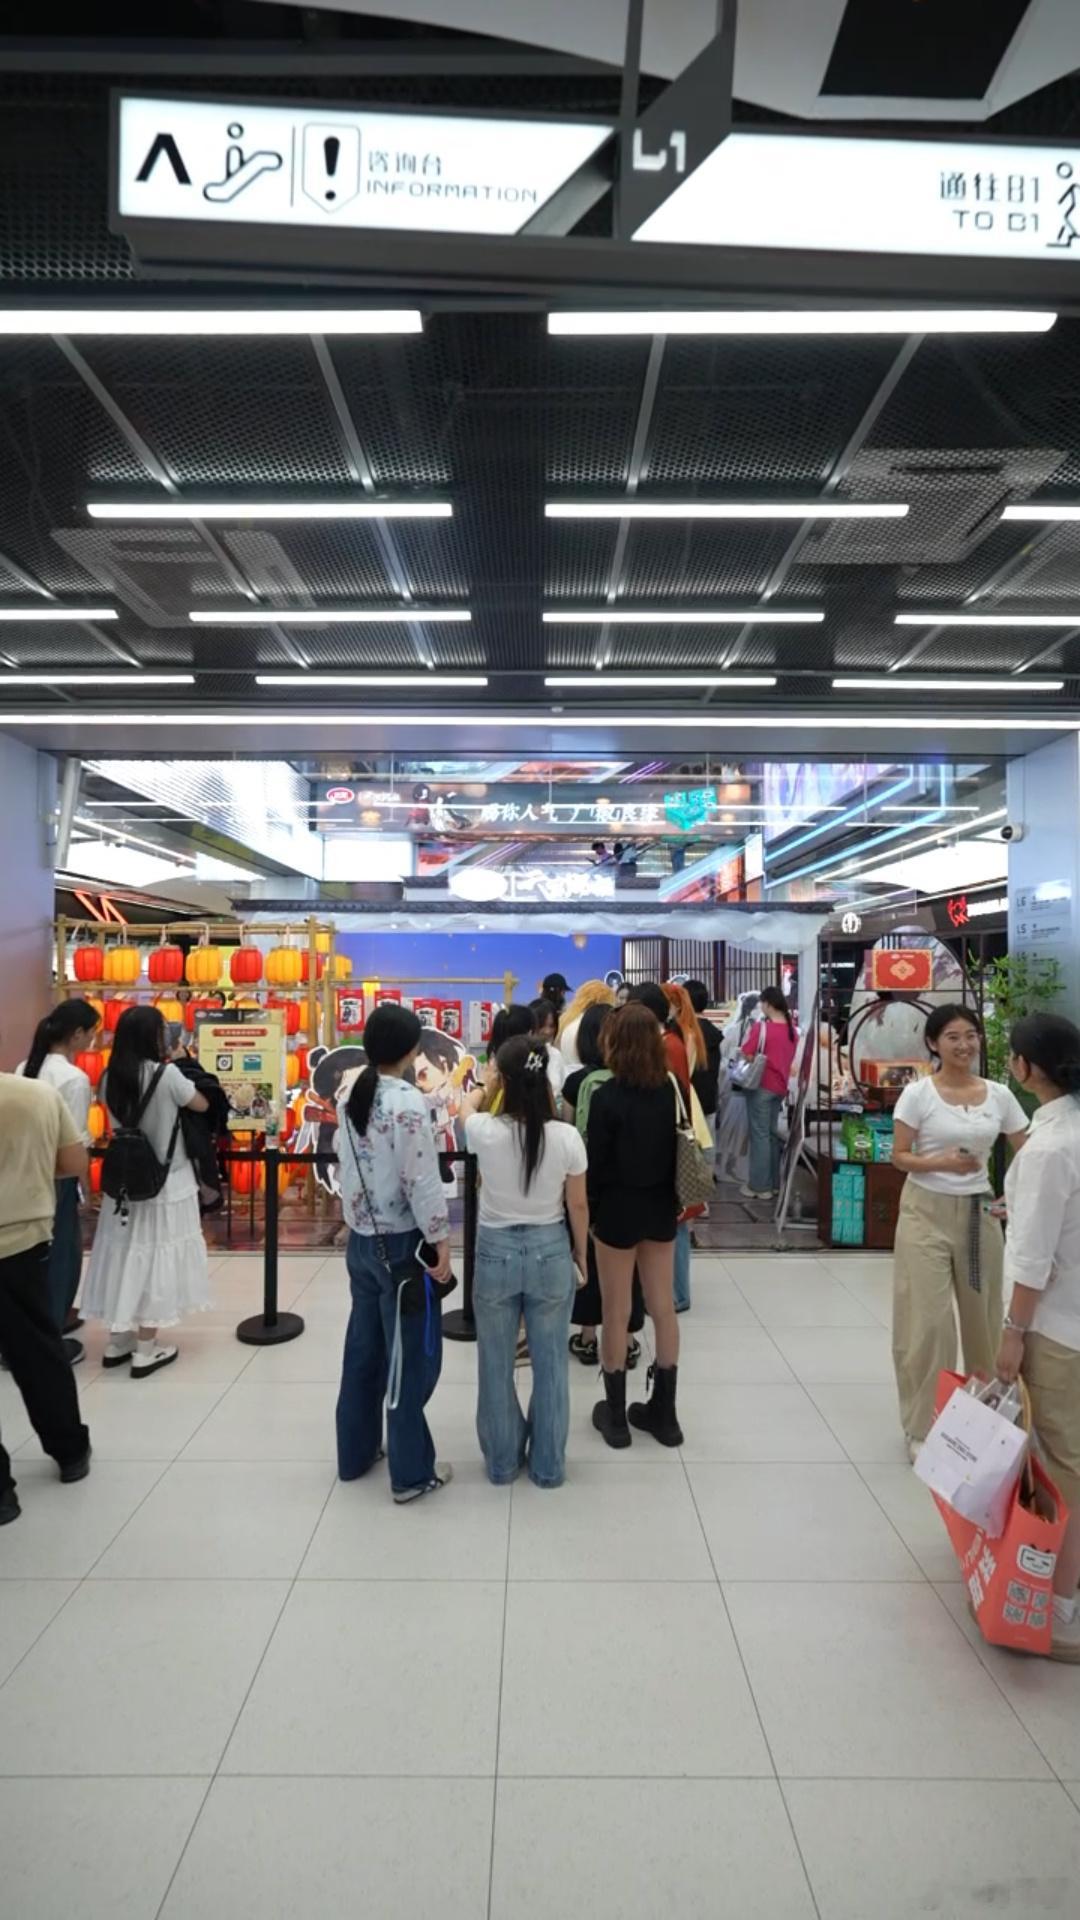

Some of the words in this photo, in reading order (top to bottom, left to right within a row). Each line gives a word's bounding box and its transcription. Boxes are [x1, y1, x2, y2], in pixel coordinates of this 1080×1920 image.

[632, 128, 686, 172] L1
[366, 180, 537, 203] INFORMATION
[952, 209, 994, 230] TO
[1008, 212, 1039, 233] B1
